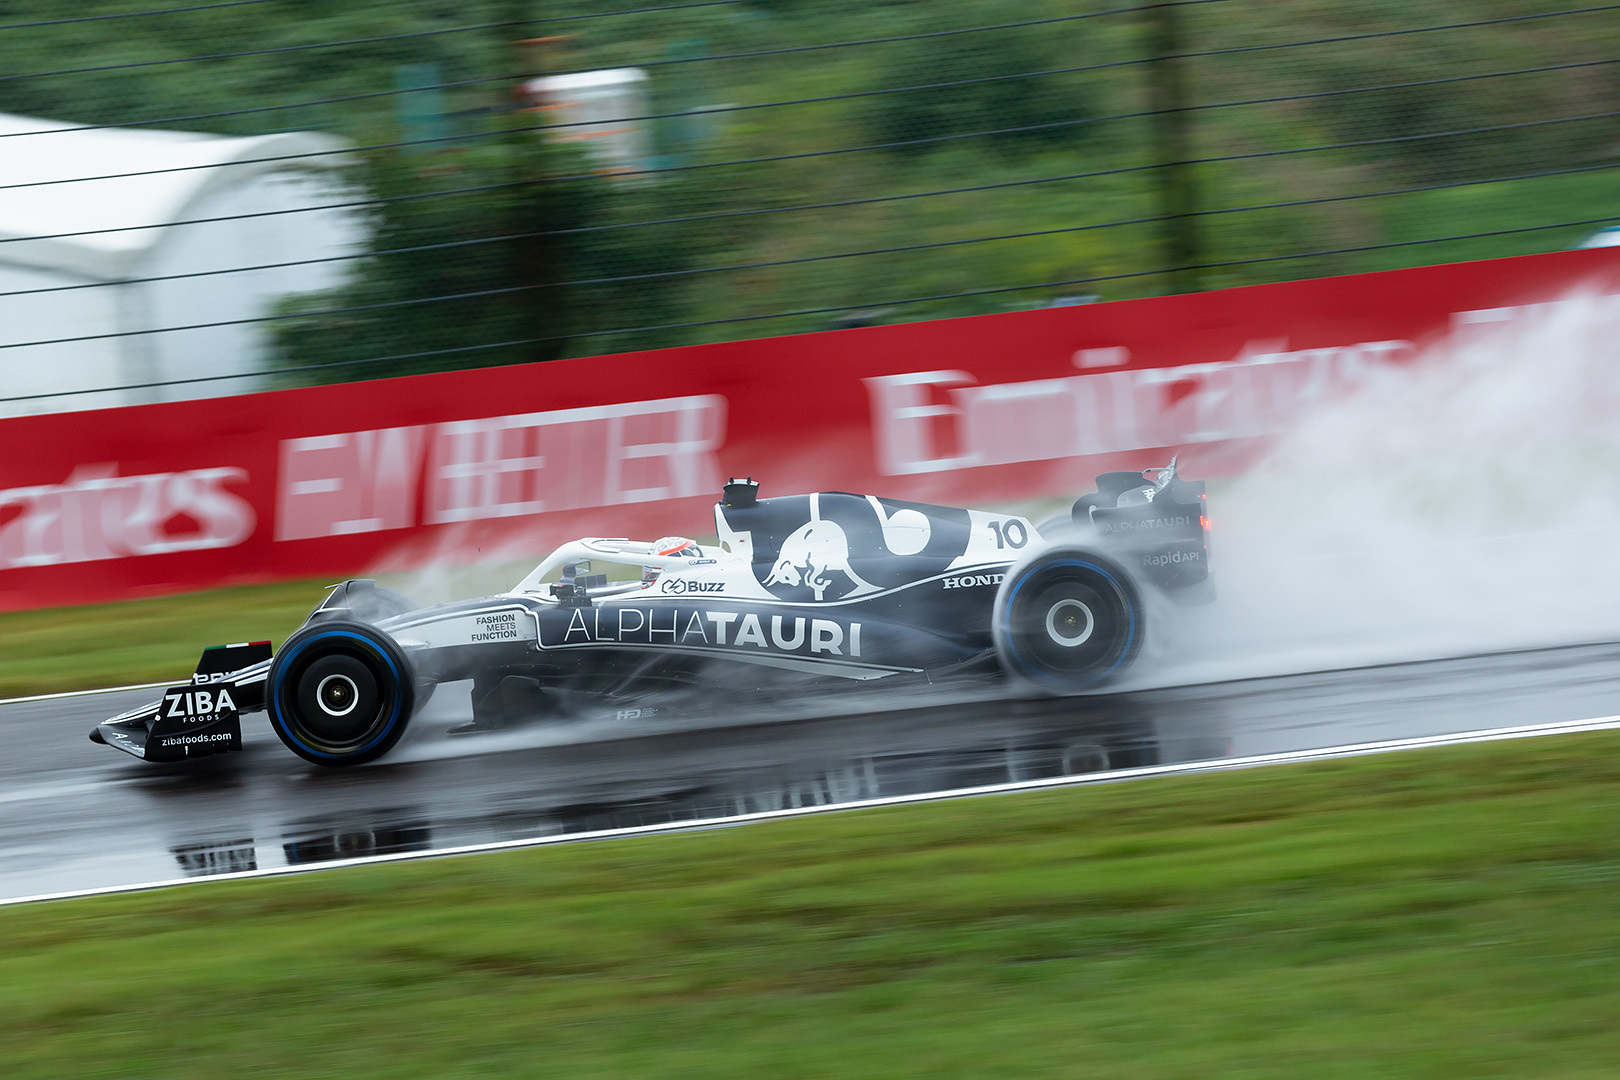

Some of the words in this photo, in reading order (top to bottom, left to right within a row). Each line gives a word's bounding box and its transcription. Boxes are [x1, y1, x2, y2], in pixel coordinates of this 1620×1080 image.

[1105, 516, 1190, 534] ALPHATAURI
[987, 518, 1029, 550] 10
[942, 573, 1007, 590] HOND
[476, 613, 515, 625] FASHION
[486, 621, 516, 632] MEETS
[471, 629, 517, 642] FUNCTION
[564, 607, 862, 657] ALPHATAURI
[165, 689, 237, 718] ZIBA
[182, 713, 220, 724] FOODS
[161, 732, 233, 747] zibafoods.com
